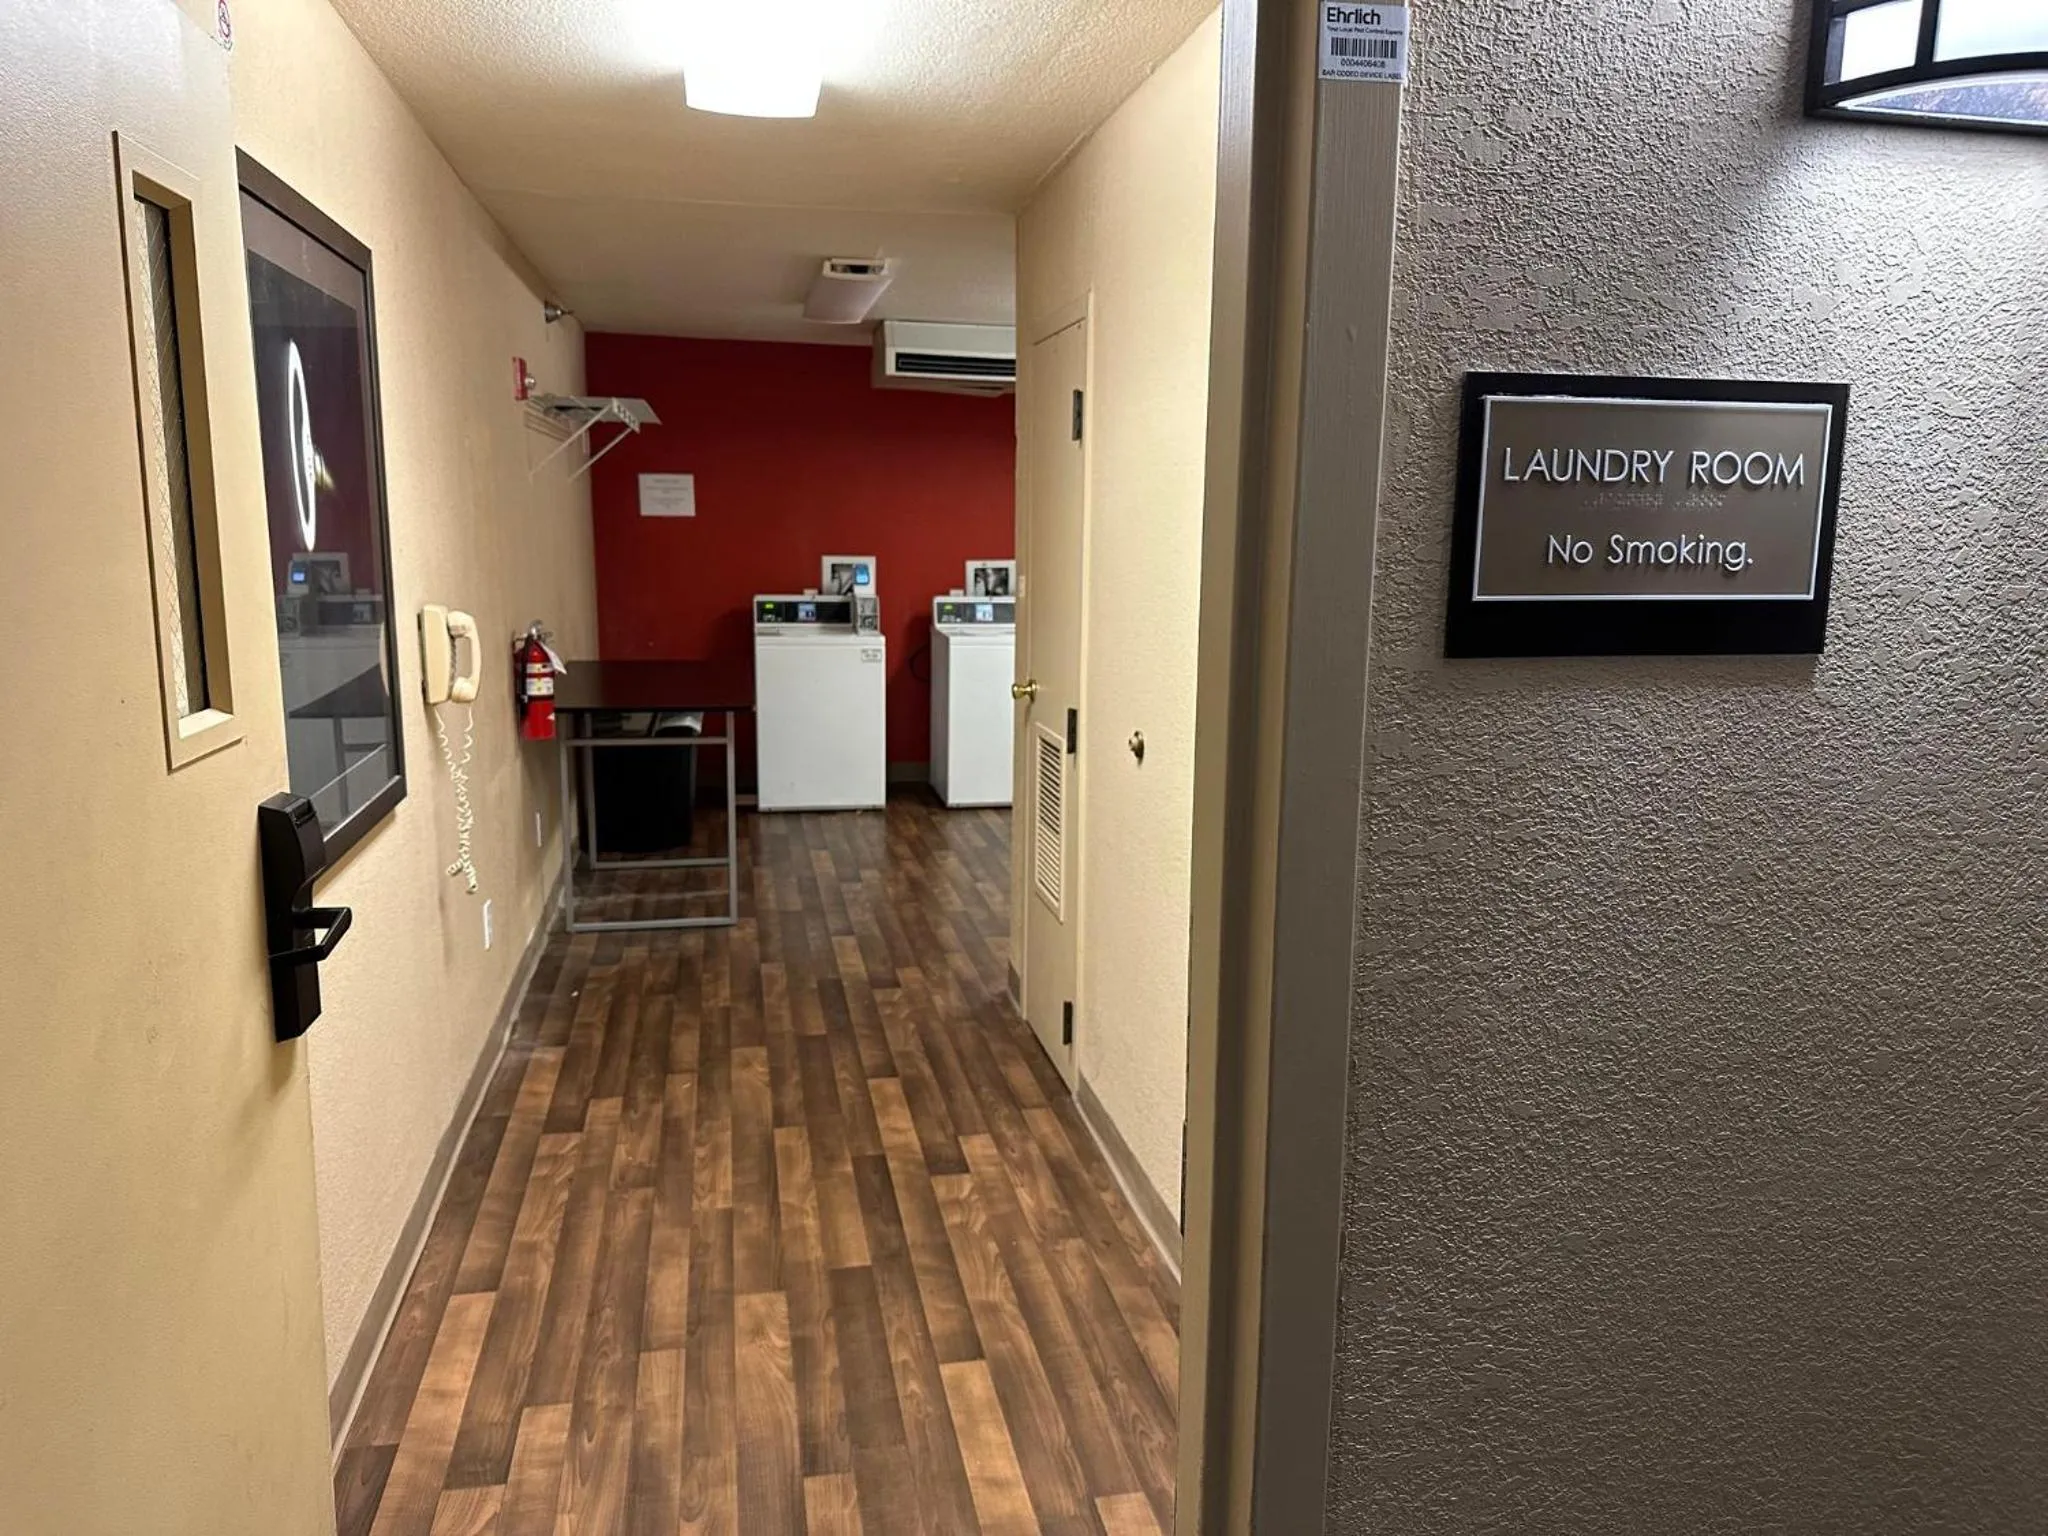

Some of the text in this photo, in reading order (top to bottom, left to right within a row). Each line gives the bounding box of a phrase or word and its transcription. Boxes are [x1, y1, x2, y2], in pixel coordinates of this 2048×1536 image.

[1327, 7, 1381, 25] Ehrlich
[1503, 446, 1805, 487] LAUNDRY ROOM
[1547, 533, 1754, 572] No Smoking.
